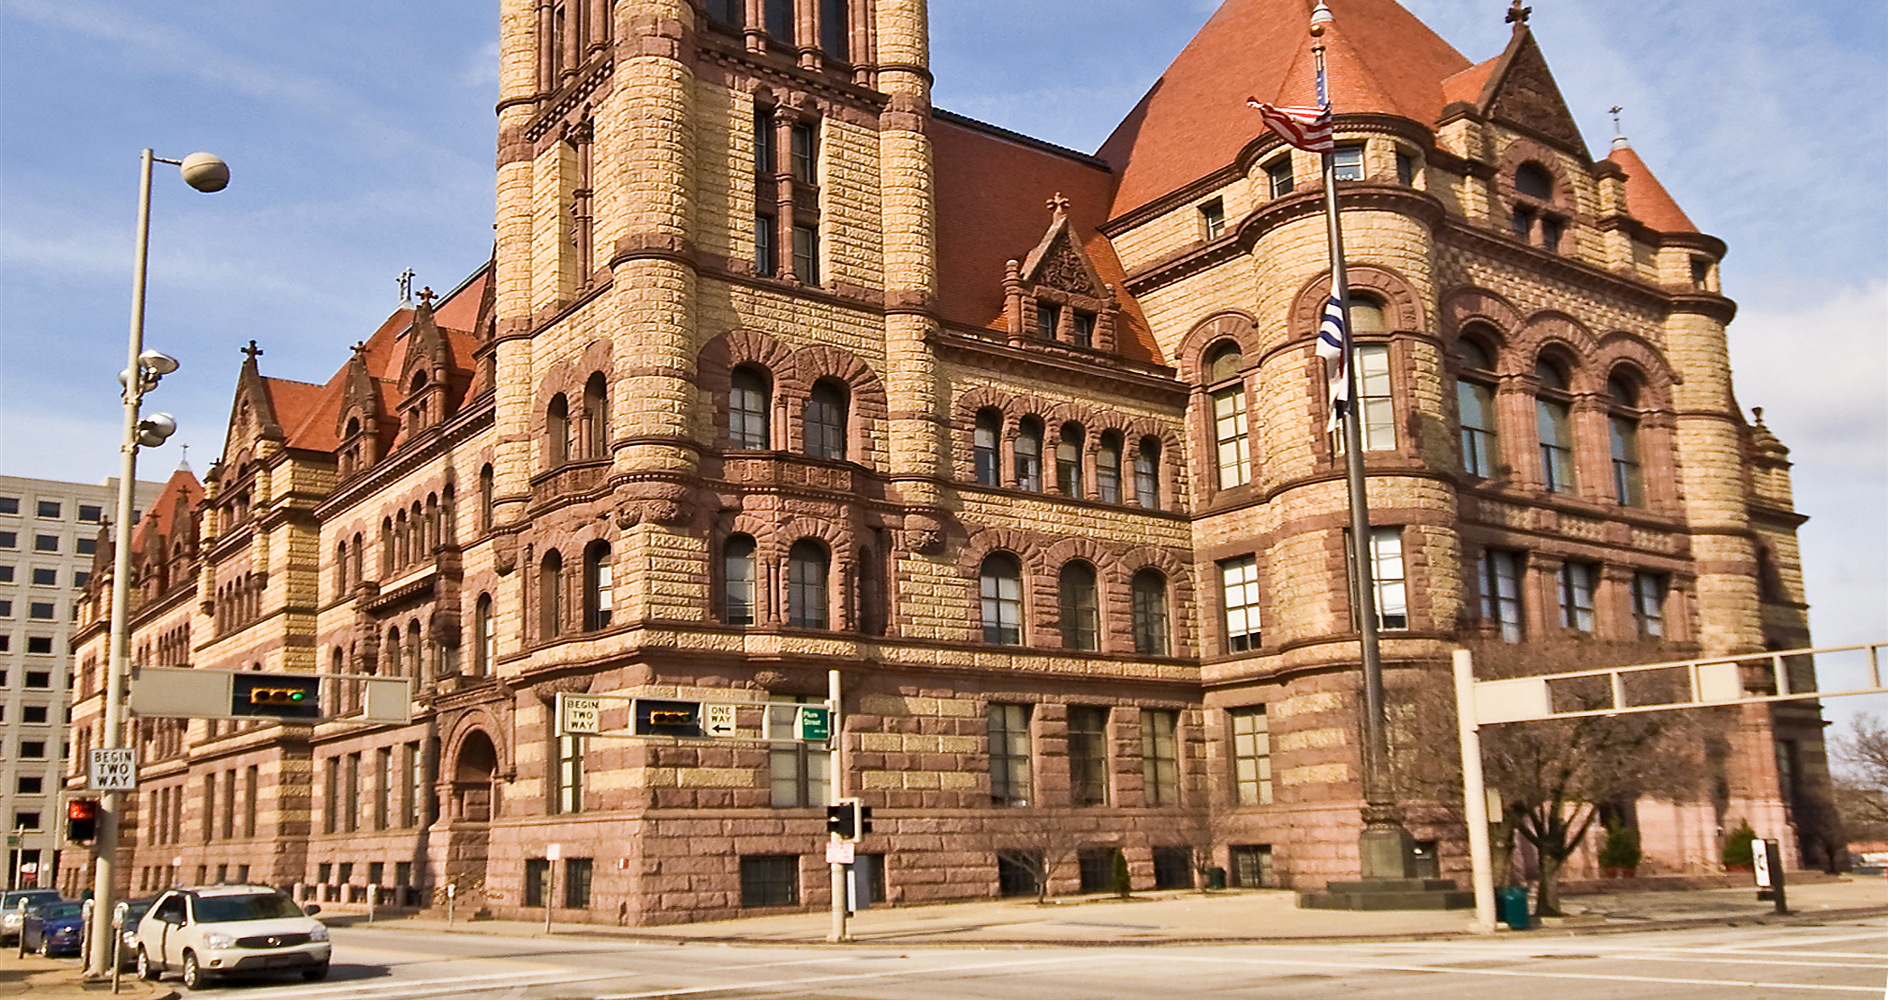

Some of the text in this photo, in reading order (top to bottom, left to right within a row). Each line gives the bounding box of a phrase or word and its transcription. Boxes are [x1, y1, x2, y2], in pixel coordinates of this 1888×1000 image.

[567, 700, 599, 709] BEGIN
[572, 711, 593, 719] TWO
[711, 706, 731, 715] ONE
[711, 715, 731, 723] WAY
[571, 721, 594, 730] WAY
[94, 751, 132, 763] BEGIN
[99, 763, 129, 775] TWO
[97, 775, 130, 787] WAY
